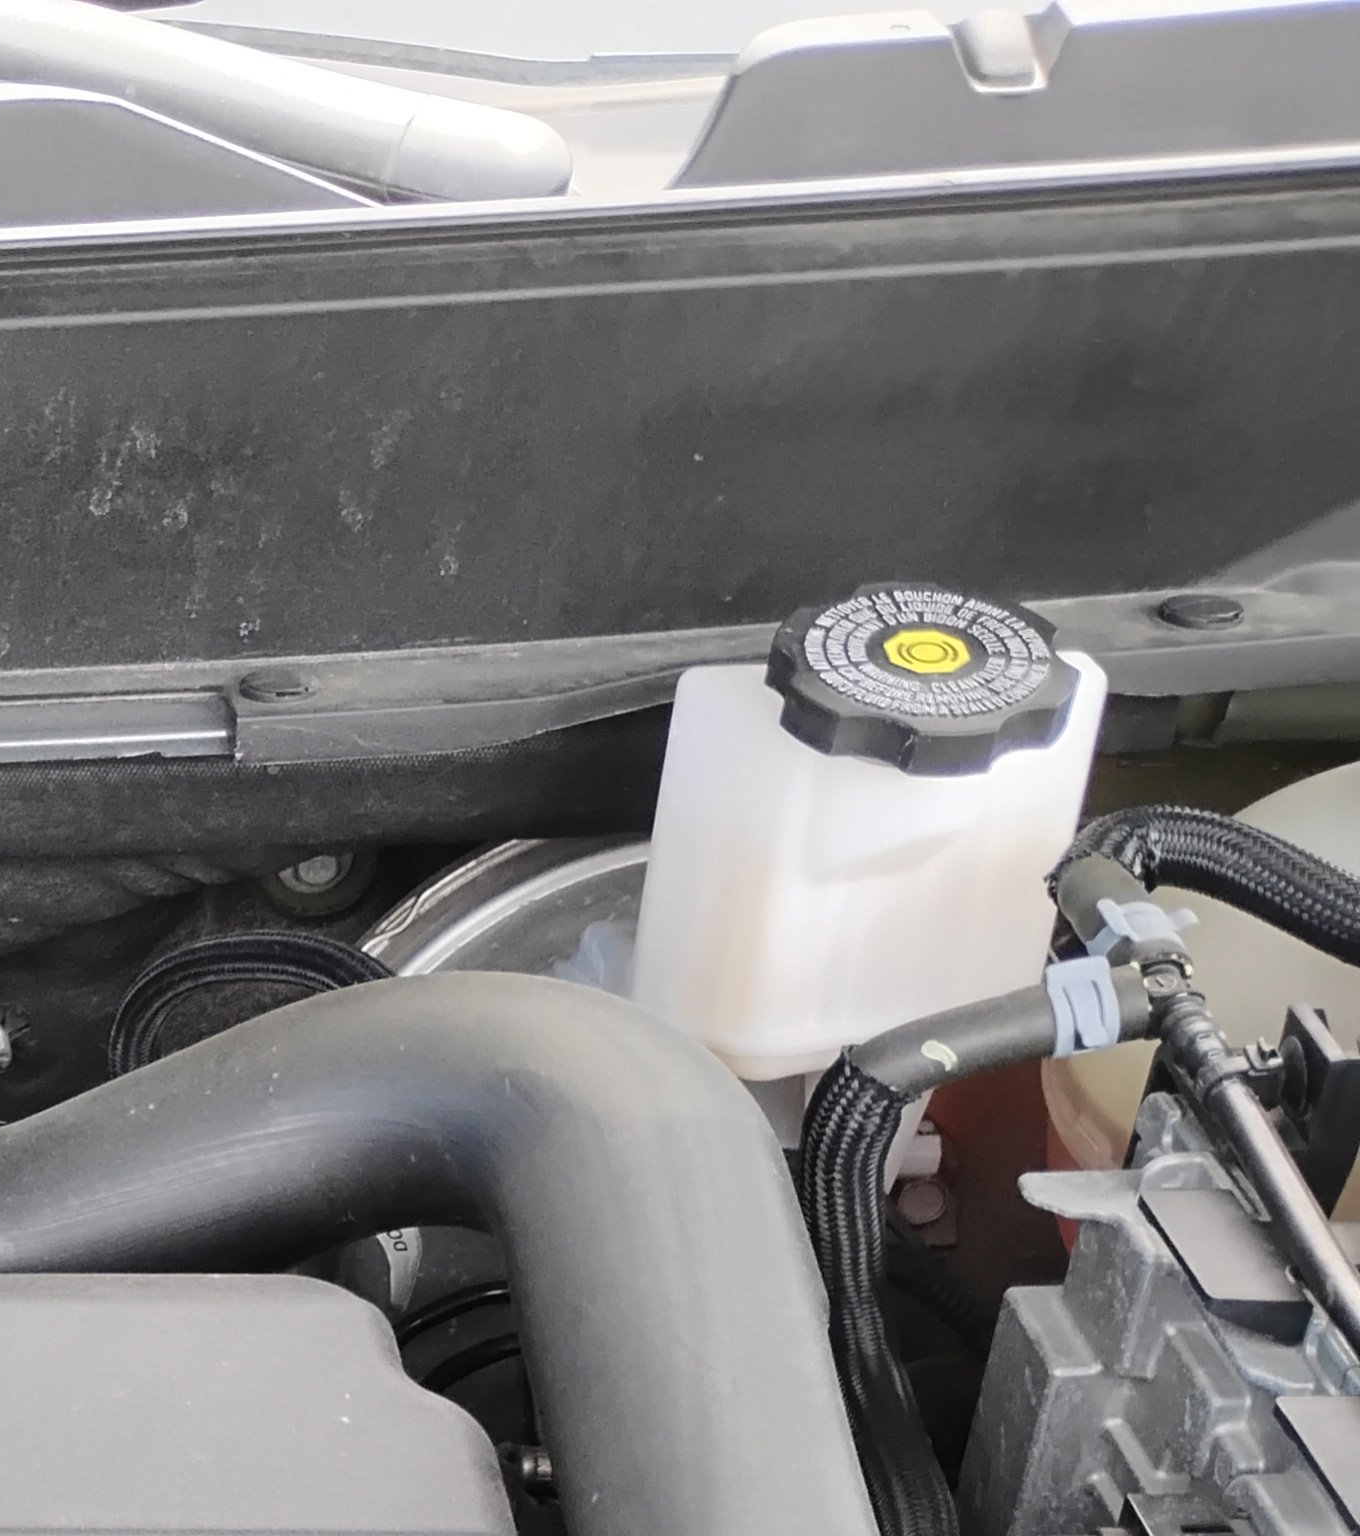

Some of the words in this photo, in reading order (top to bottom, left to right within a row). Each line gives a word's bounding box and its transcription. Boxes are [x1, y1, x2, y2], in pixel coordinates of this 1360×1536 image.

[871, 591, 893, 605] LE
[893, 589, 964, 606] BOUCHON
[964, 598, 1010, 620] AVANT
[1003, 616, 1027, 630] LA
[875, 603, 897, 615] DU
[899, 601, 955, 614] LIQUIDE
[957, 608, 978, 620] DE
[923, 612, 969, 629] BIDON
[930, 679, 979, 694] CLEAN
[950, 696, 1006, 717] SEALED
